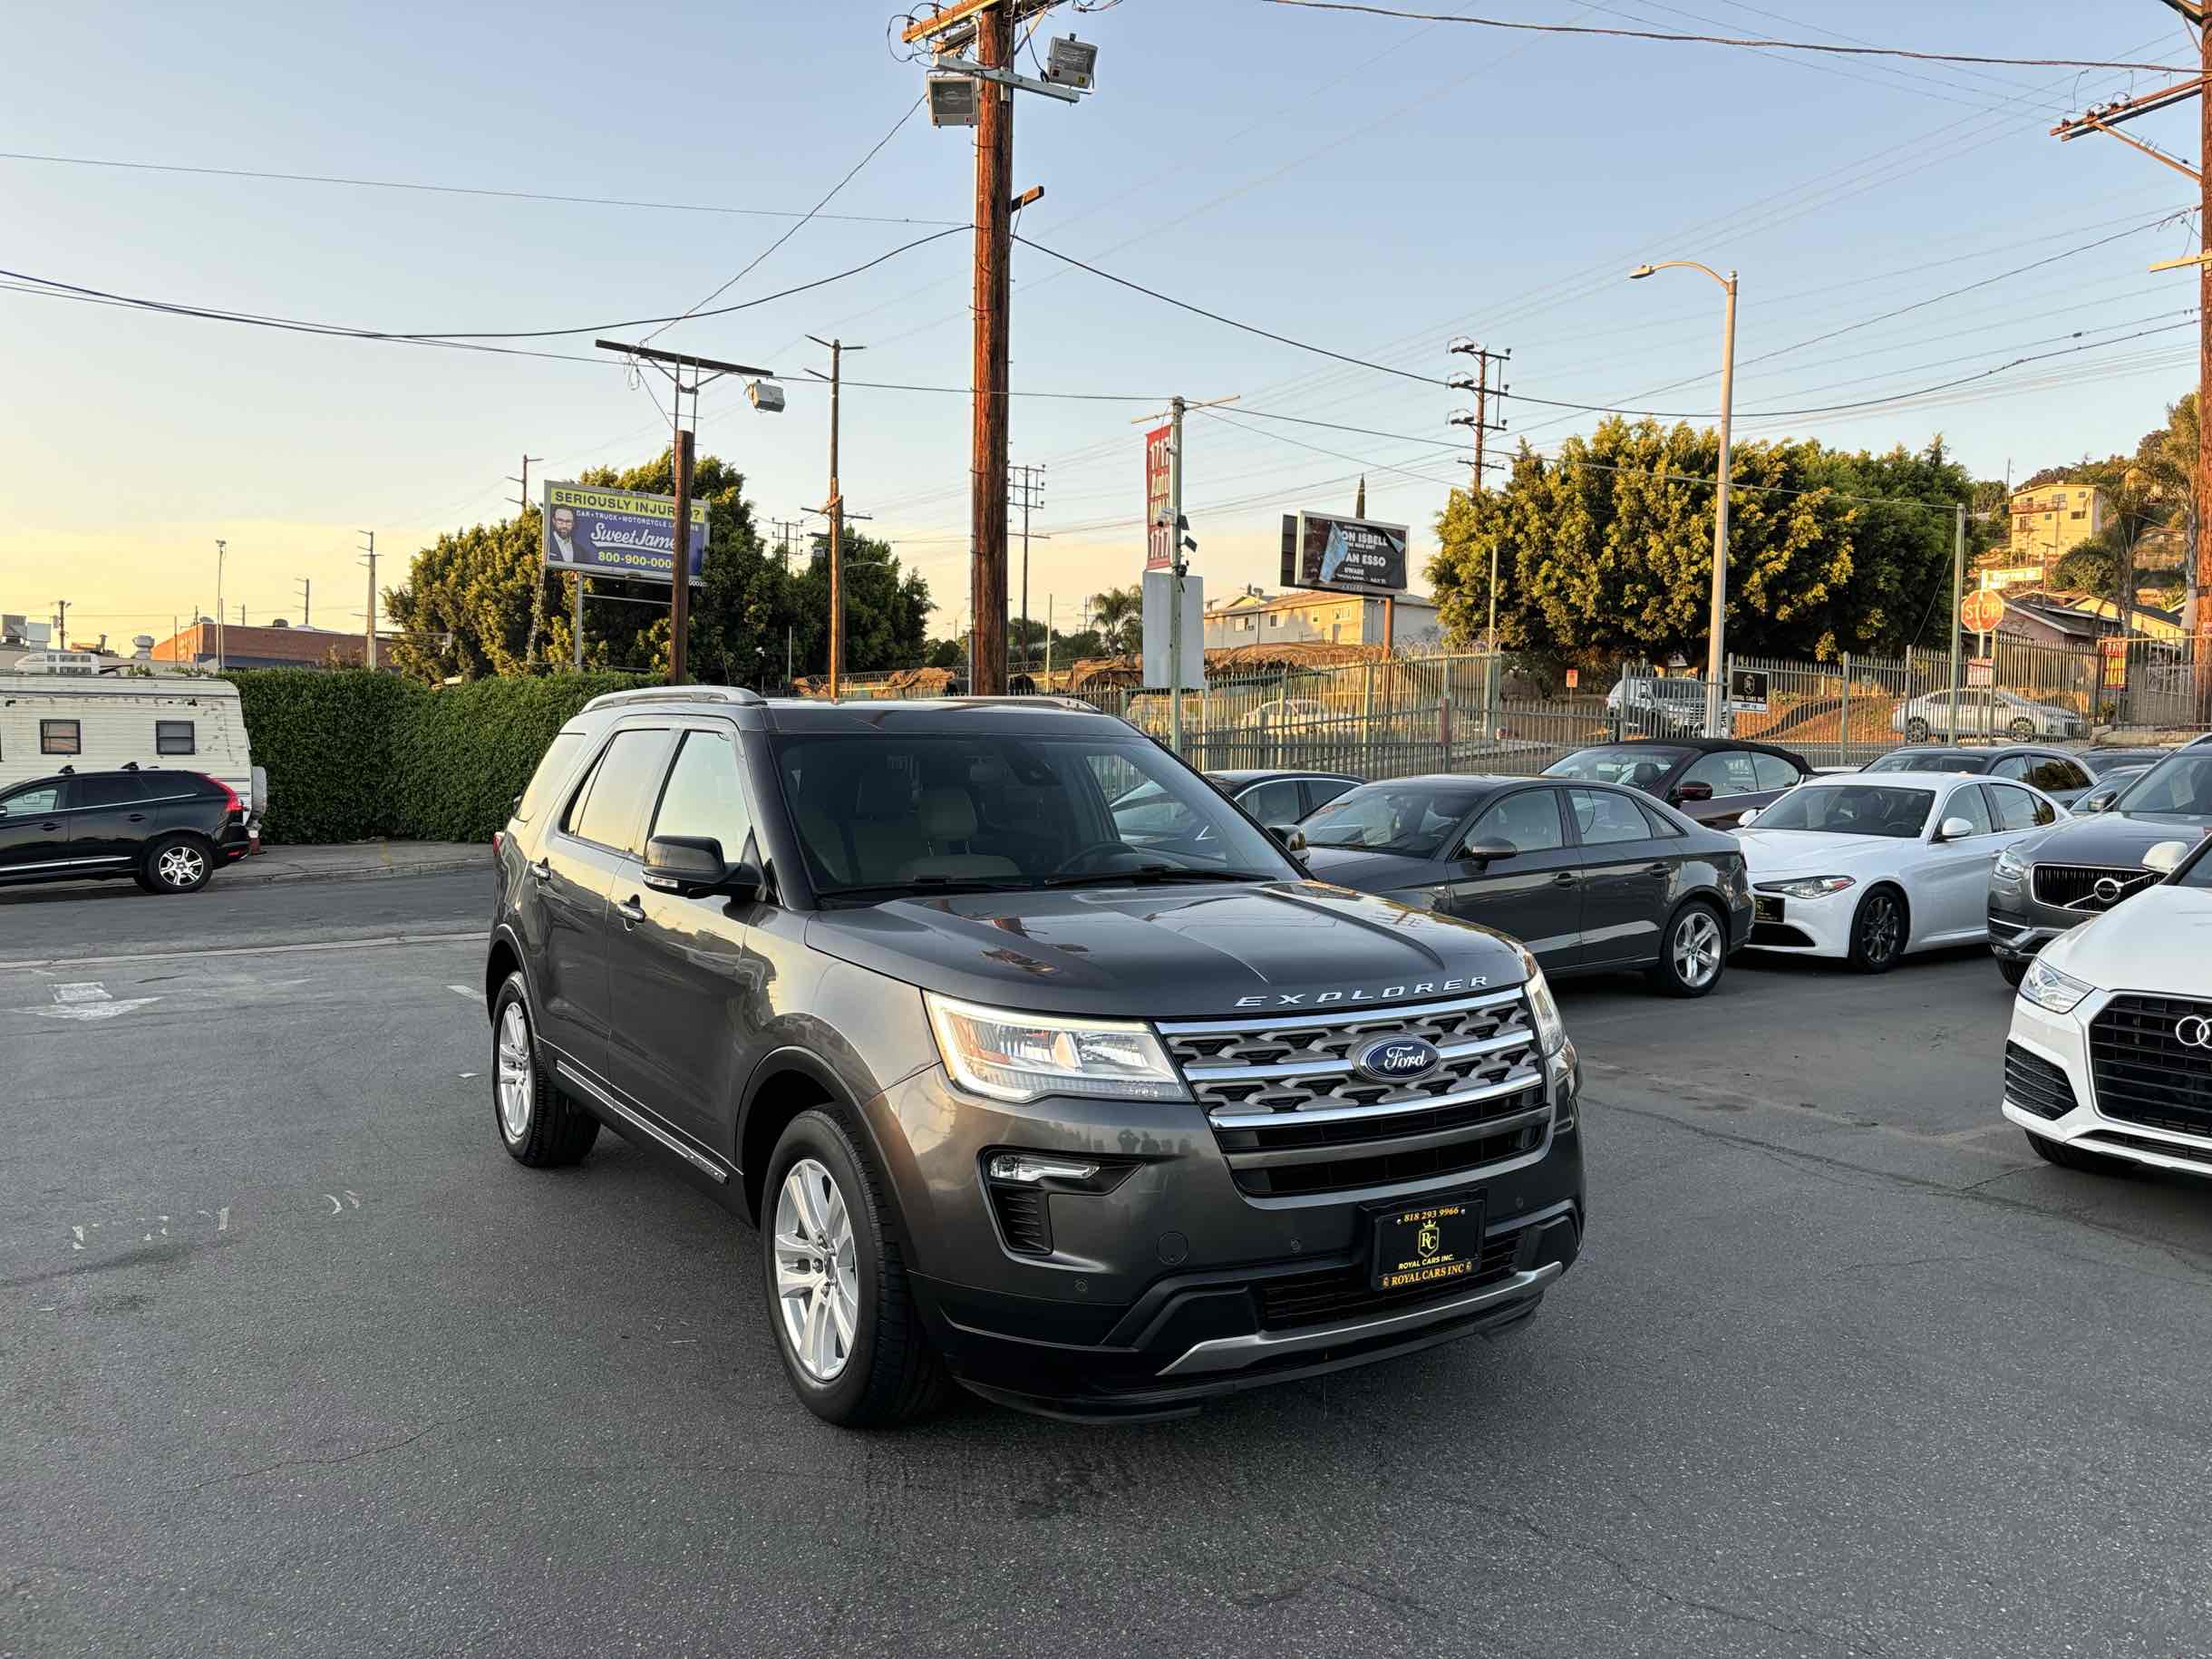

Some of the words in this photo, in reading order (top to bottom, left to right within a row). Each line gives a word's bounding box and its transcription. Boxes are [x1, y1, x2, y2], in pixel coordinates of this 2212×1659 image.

[555, 490, 631, 511] SERIOUSLY
[590, 522, 636, 545] Sweet
[635, 529, 675, 549] Jame
[1358, 533, 1388, 547] ISBELL
[597, 550, 675, 569] 800-900-000
[1362, 554, 1386, 568] ESSO
[1965, 600, 2000, 620] STOP
[1233, 975, 1488, 1007] EXPLORER
[1383, 1046, 1428, 1069] Ford
[1403, 1211, 1420, 1222] 818
[1421, 1209, 1437, 1220] 293
[1421, 1232, 1437, 1249] RC
[1399, 1260, 1421, 1269] ROYAL
[1422, 1256, 1440, 1266] CARS
[1441, 1254, 1454, 1262] INC.
[1392, 1271, 1421, 1285] ROYAL
[1421, 1266, 1446, 1280] CARS
[1447, 1264, 1465, 1276] INC
